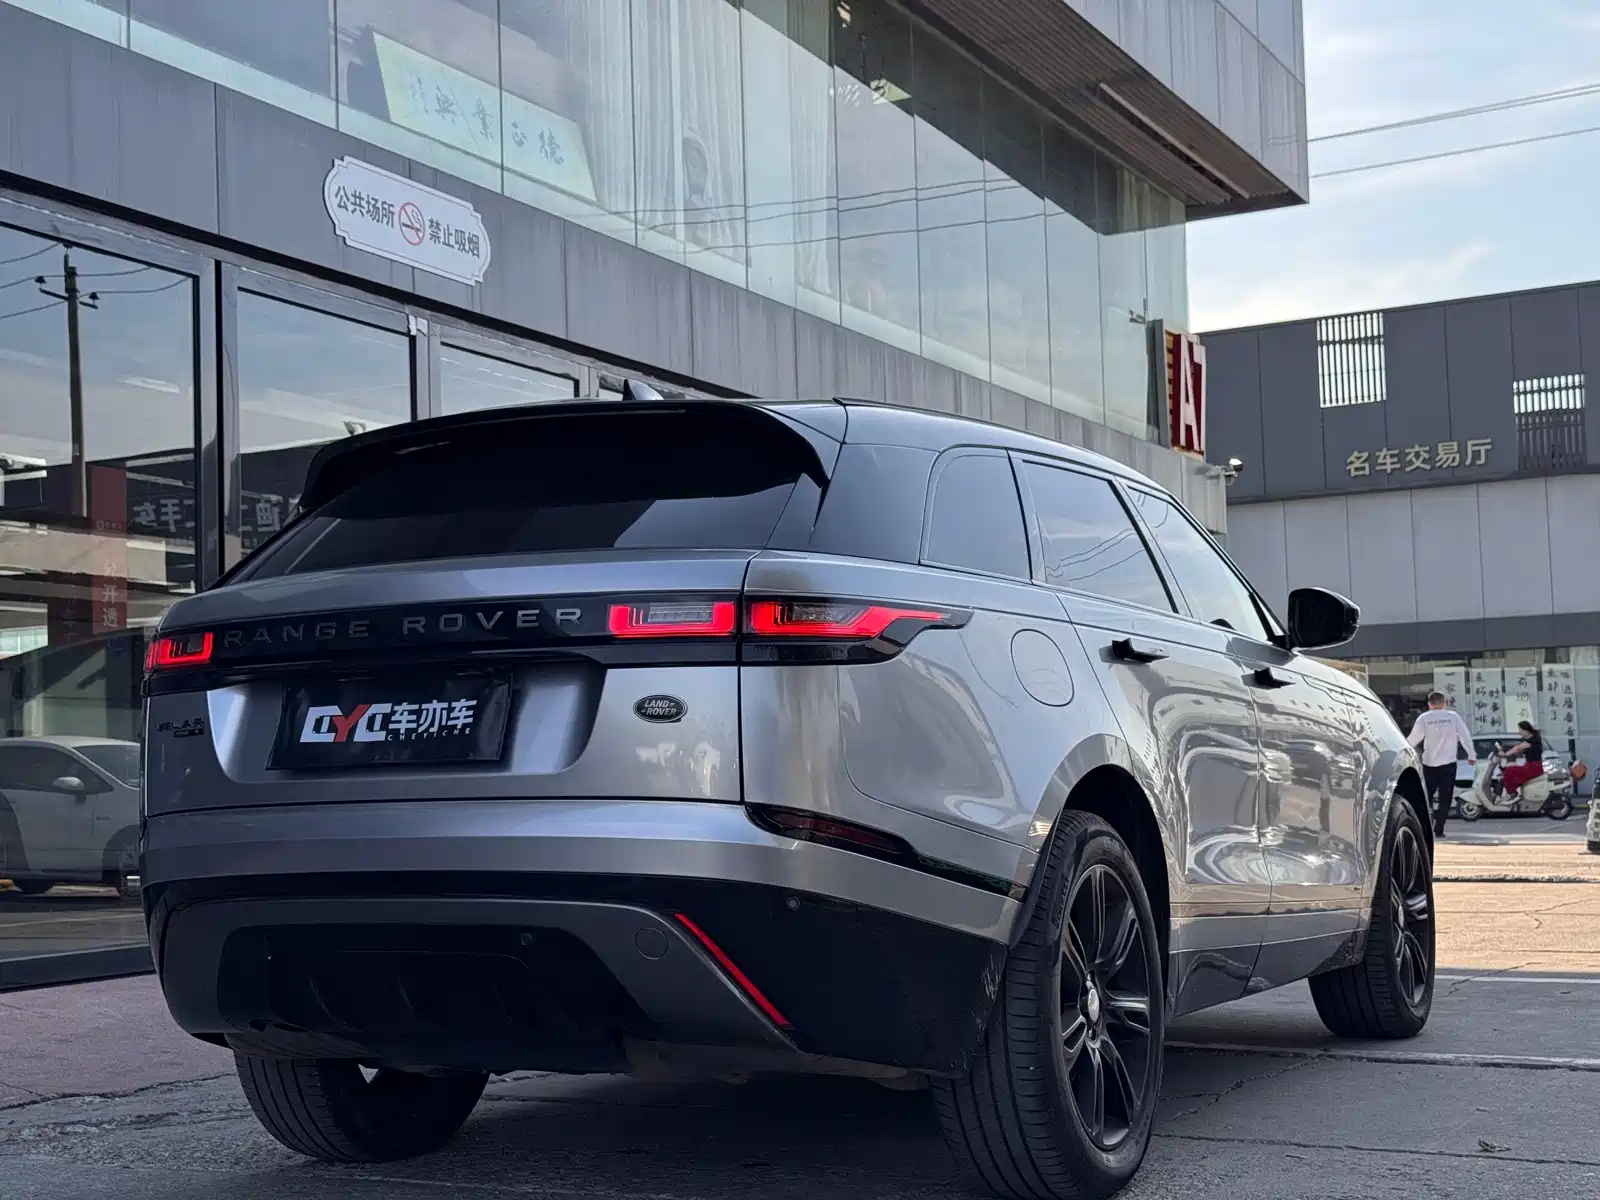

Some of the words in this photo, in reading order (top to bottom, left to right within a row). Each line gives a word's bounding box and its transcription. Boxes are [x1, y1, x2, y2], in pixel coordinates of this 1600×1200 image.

[335, 185, 395, 228] 公共场所
[428, 218, 480, 259] 禁止吸烟
[1346, 438, 1492, 477] 名车交易厅
[223, 620, 370, 648] RANGE
[402, 607, 582, 635] ROVER
[389, 699, 477, 734] 车亦车
[644, 699, 669, 708] LAND
[646, 707, 676, 716] ROVER
[387, 727, 472, 742] CHEYICHE
